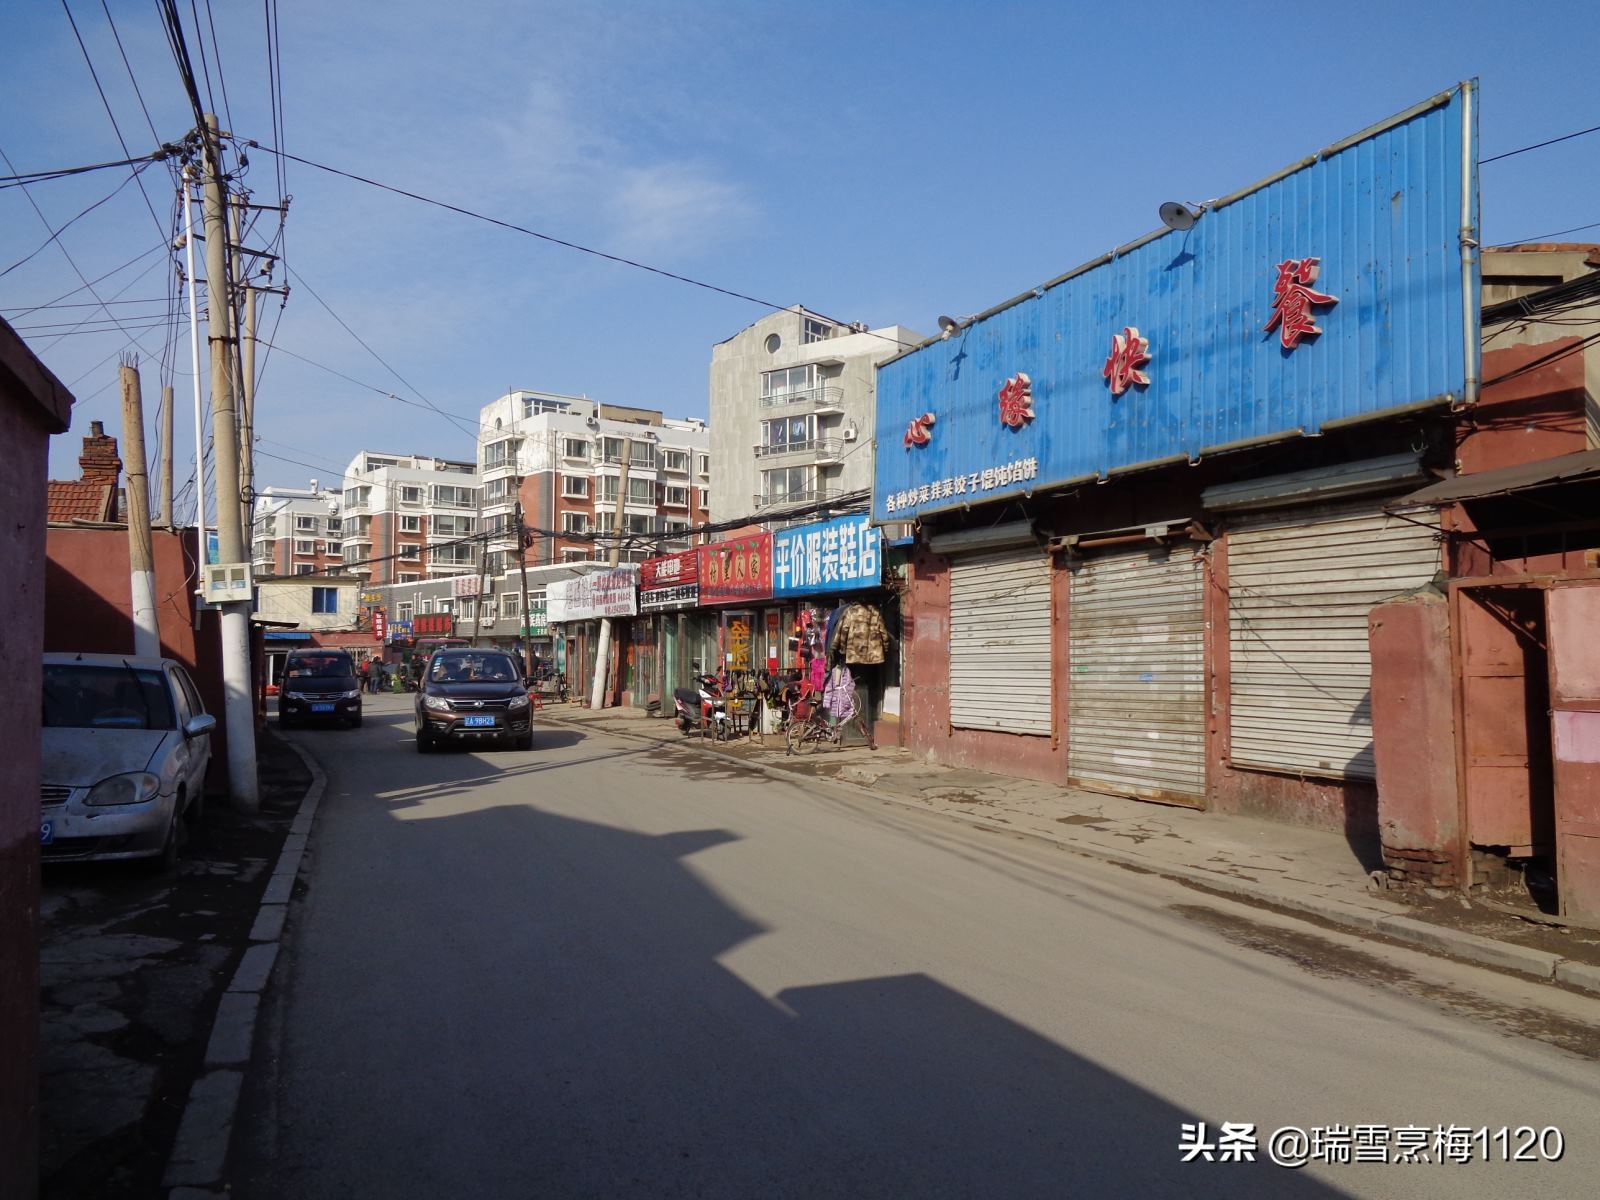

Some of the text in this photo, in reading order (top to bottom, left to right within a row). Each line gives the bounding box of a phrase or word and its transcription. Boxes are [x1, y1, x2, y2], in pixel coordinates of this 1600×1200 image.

[903, 257, 1339, 449] 心缘快餐
[885, 456, 1038, 513] 各种炒菜拌菜饺子馄饨馅饼
[775, 518, 876, 589] 平价服装鞋店
